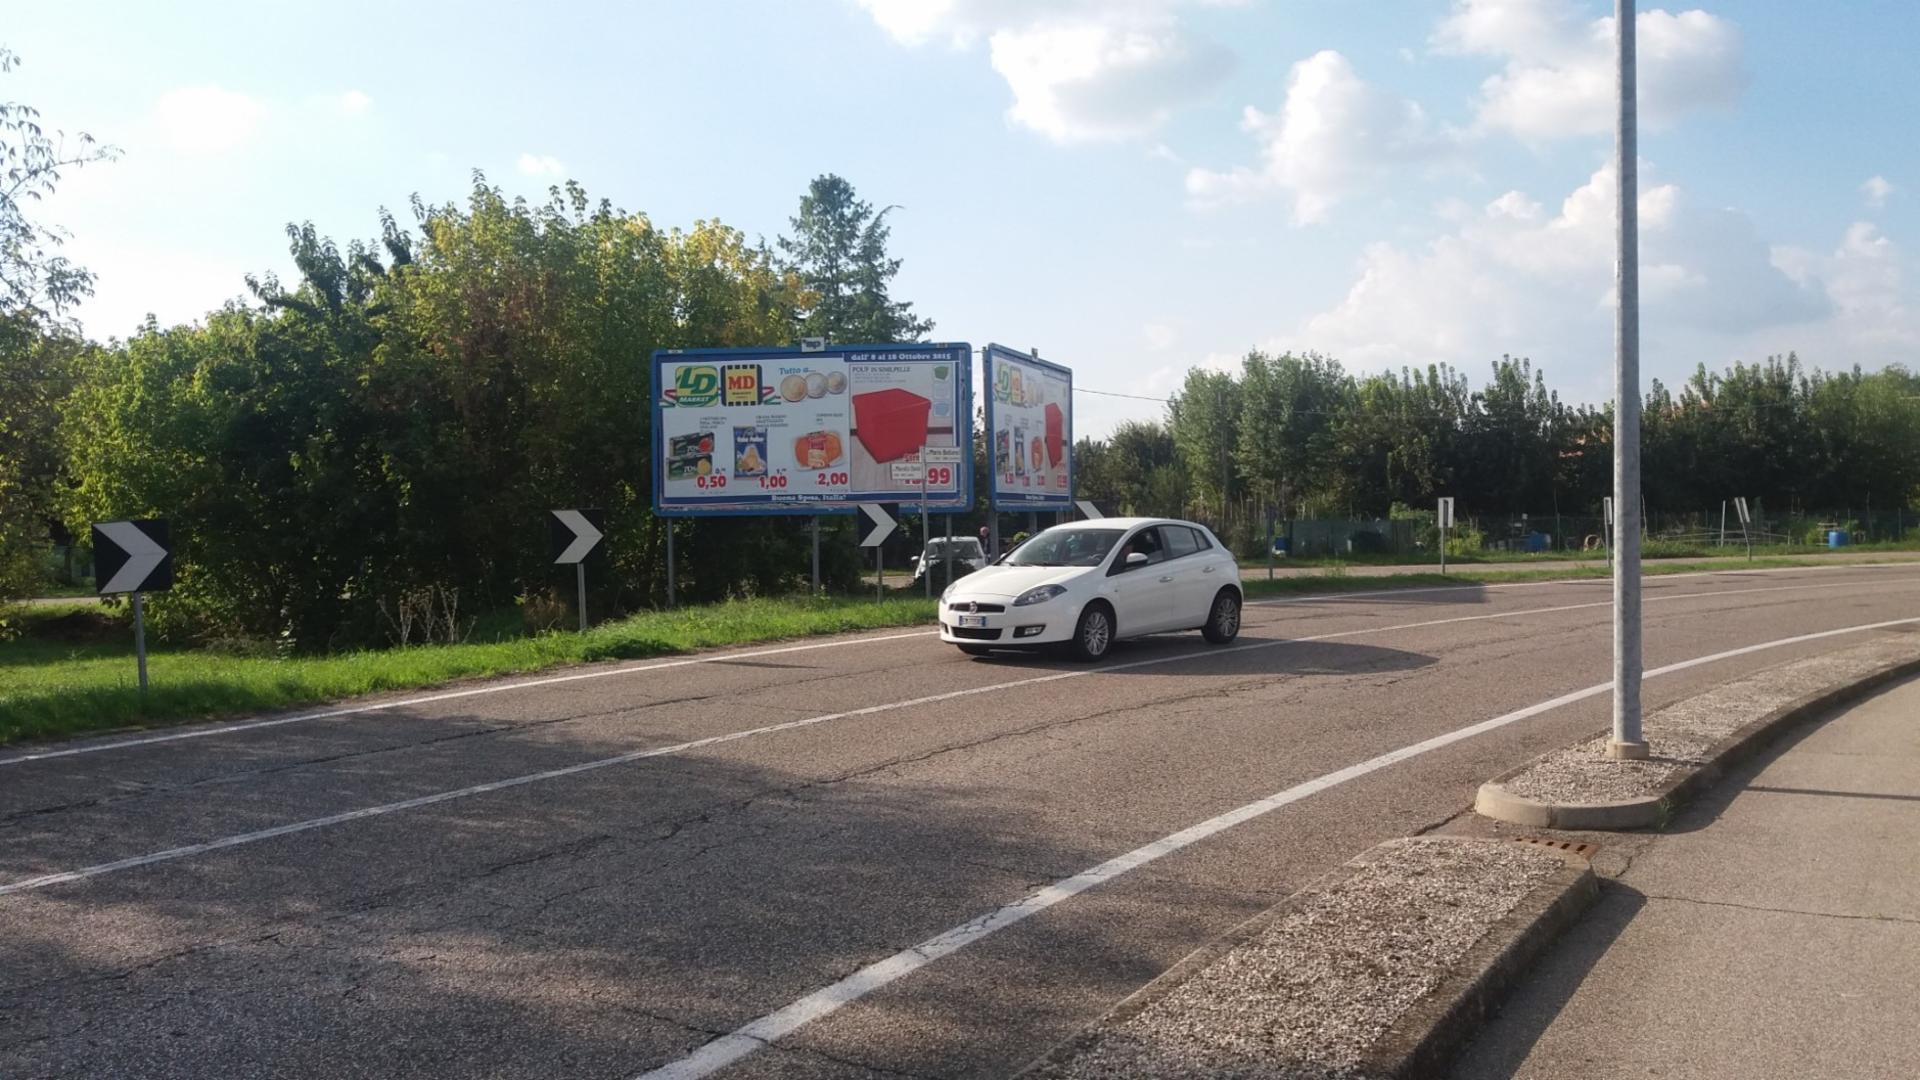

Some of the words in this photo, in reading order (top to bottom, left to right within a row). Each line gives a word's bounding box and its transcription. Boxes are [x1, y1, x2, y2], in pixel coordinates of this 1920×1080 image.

[779, 367, 801, 375] Tutto
[728, 375, 755, 390] MD
[697, 476, 726, 489] 0,50
[759, 476, 787, 489] 1,00
[818, 472, 848, 487] 2,00
